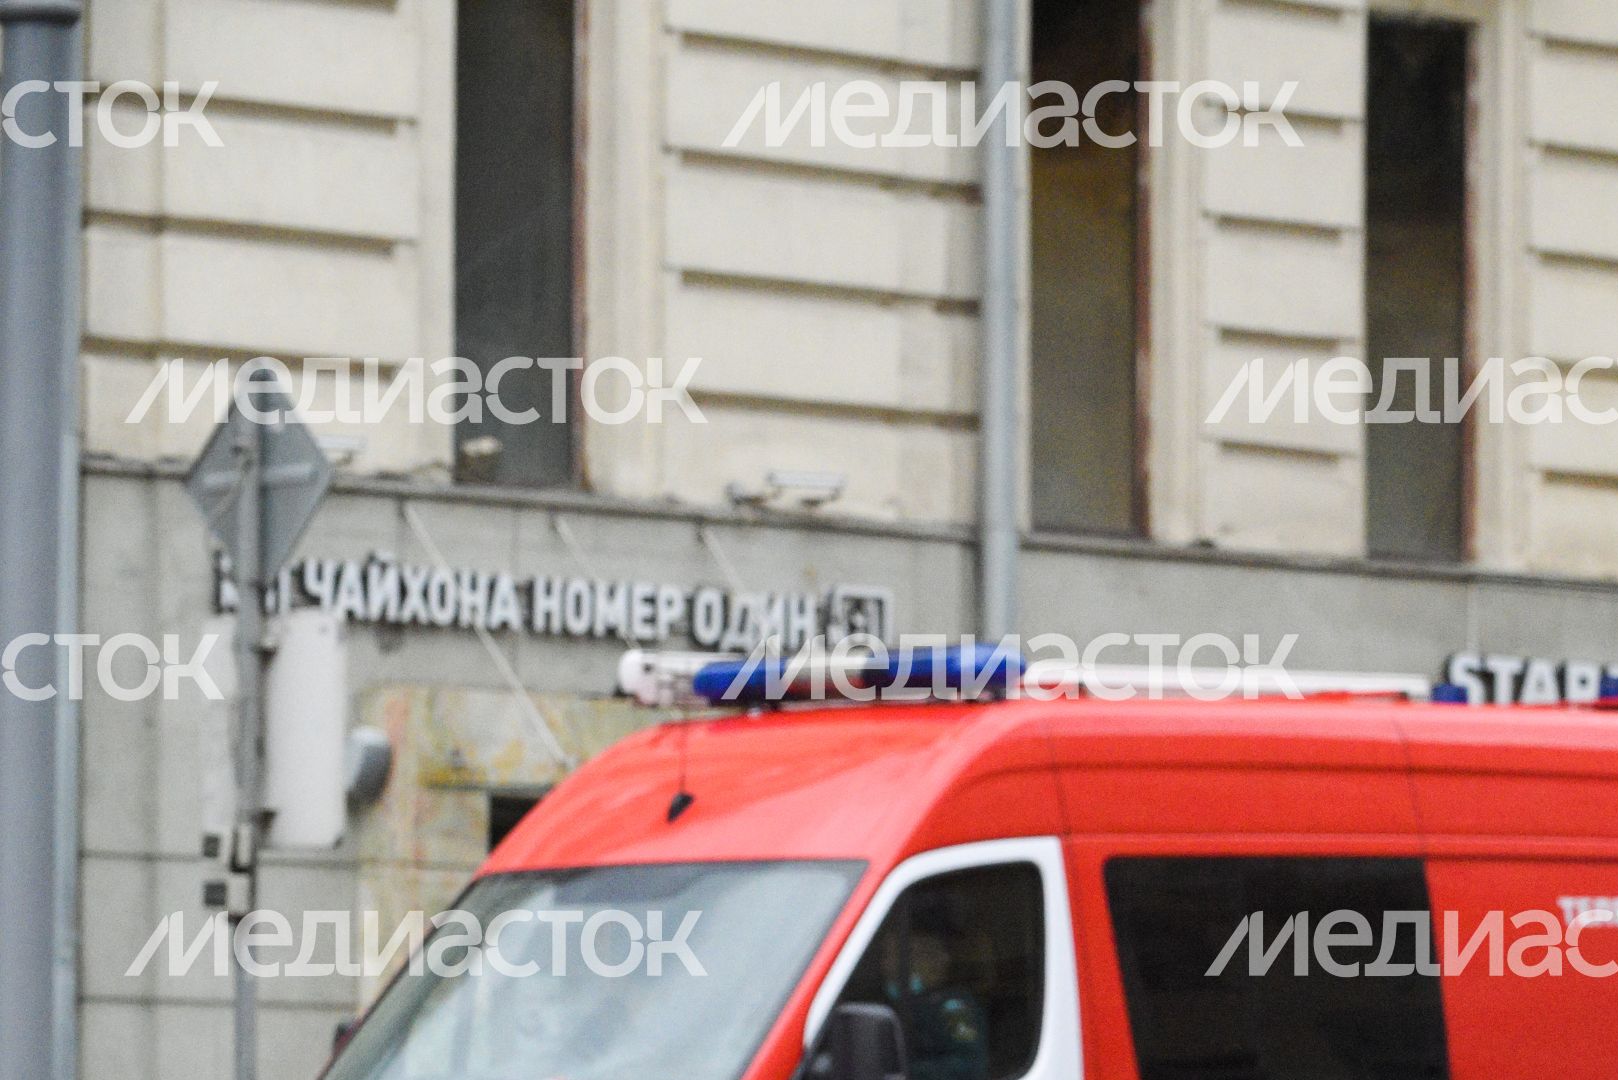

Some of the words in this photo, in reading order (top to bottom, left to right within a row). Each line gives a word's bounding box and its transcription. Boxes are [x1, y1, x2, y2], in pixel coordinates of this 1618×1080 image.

[304, 552, 522, 632] ЧАЙХОНА
[533, 576, 684, 641] НОМЕР
[694, 588, 816, 651] ОДИН
